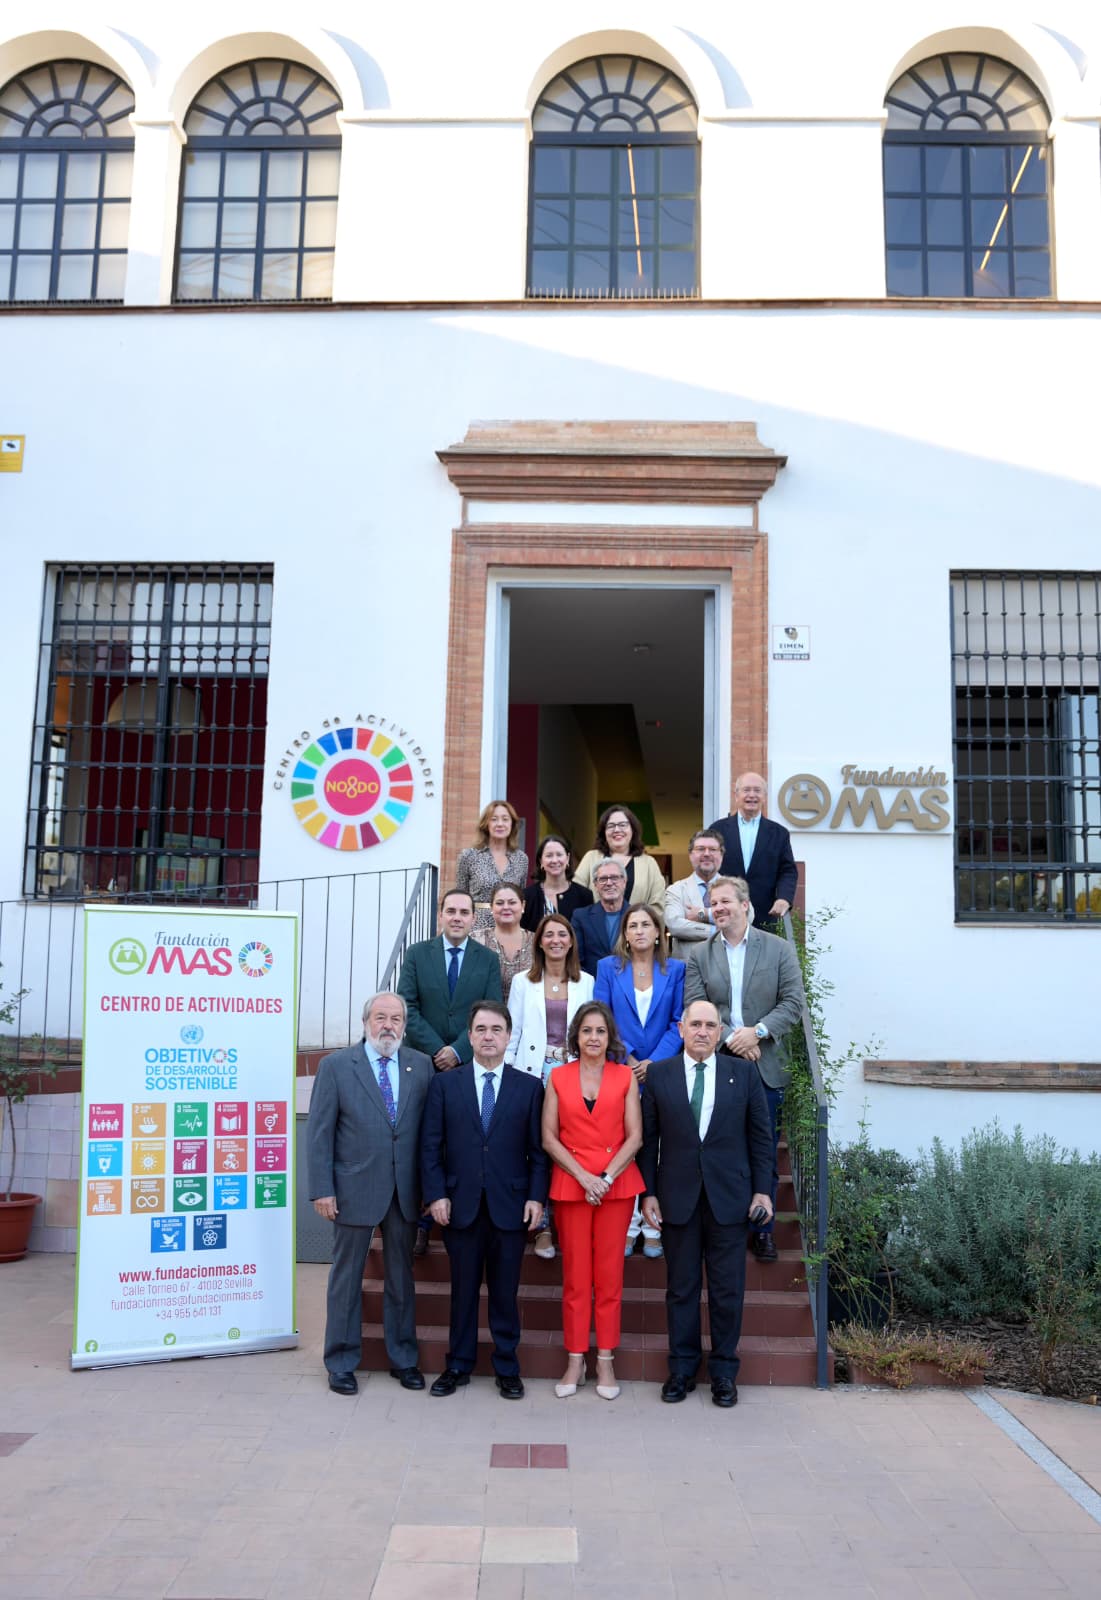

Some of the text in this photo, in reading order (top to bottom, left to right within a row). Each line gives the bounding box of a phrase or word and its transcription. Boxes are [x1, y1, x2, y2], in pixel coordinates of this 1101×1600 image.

[273, 713, 434, 798] CENTRO de ACTIVIDADES
[841, 764, 949, 787] Fundación
[829, 787, 951, 831] MAS
[154, 931, 230, 947] Fundación
[146, 946, 233, 976] MAS
[100, 995, 283, 1014] CENTRO DE ACTIVIDADES
[144, 1048, 238, 1063] OBJETIVOS
[145, 1065, 238, 1076] DE DESARROLLO
[145, 1077, 238, 1090] SOSTENIBLE
[118, 1263, 257, 1283] www.fundacionmas.es
[122, 1285, 145, 1297] Calle
[180, 1281, 190, 1293] 67
[224, 1277, 253, 1289] Sevilla
[111, 1290, 264, 1310] fundacionmas@fundacionmas.es
[156, 1309, 172, 1320] +34
[209, 1304, 222, 1317] 131
